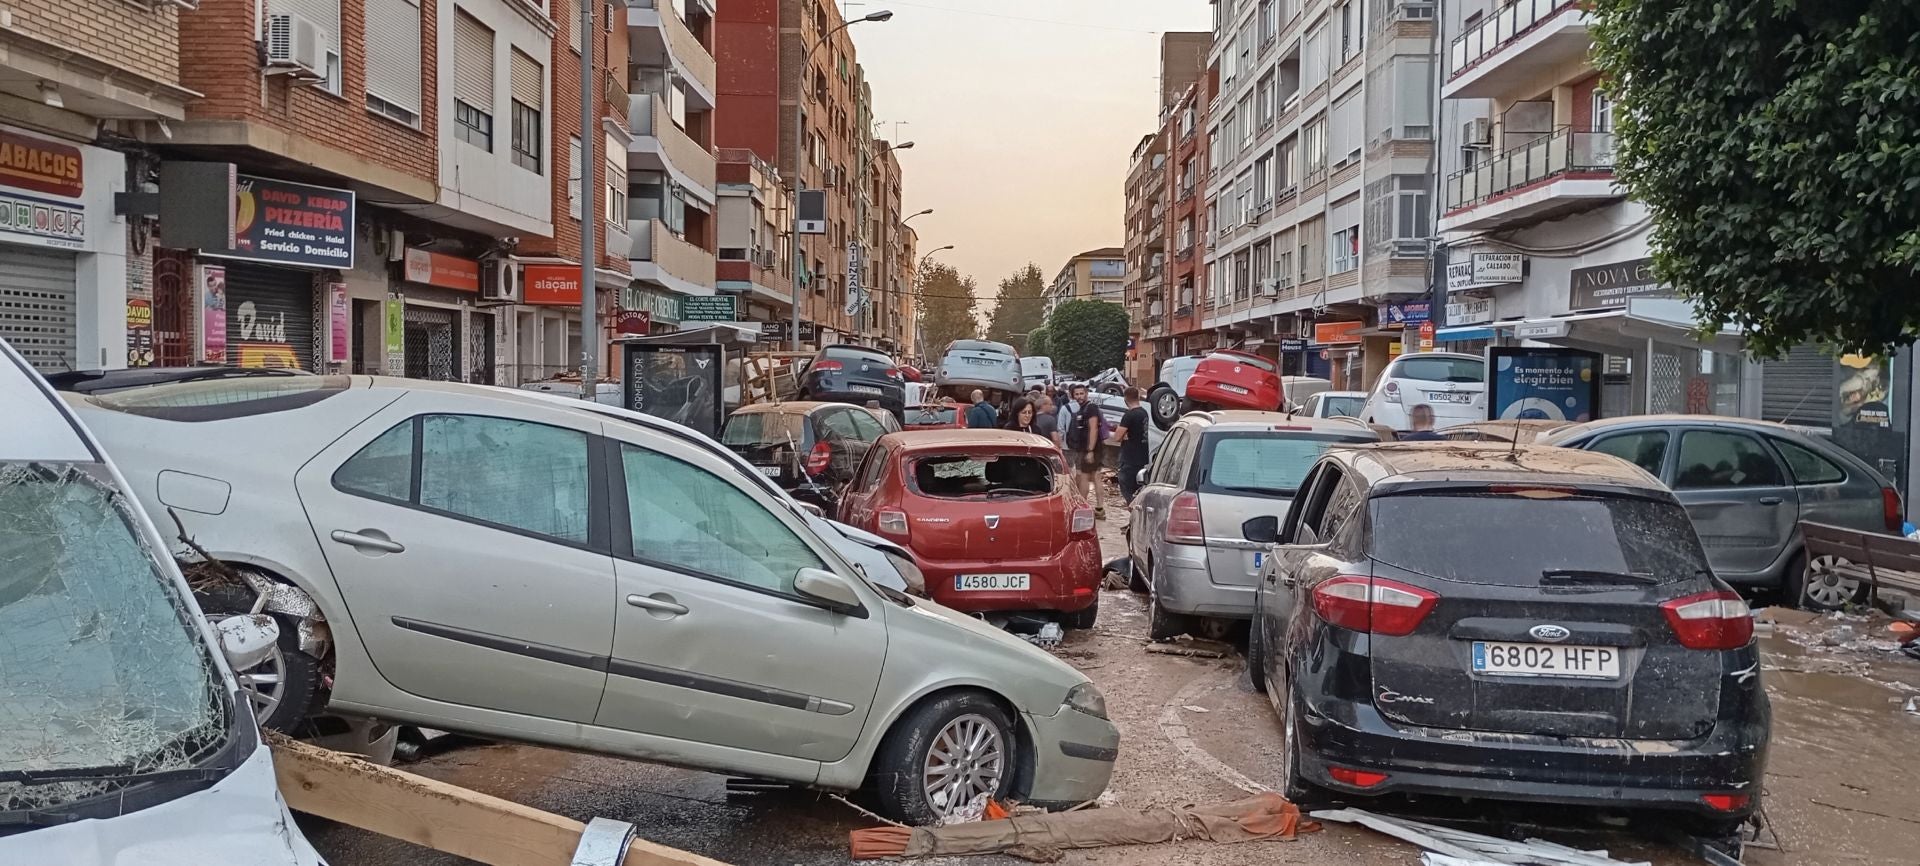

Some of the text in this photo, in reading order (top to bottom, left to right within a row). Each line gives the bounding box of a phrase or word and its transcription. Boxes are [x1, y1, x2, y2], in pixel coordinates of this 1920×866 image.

[0, 142, 78, 179] ABACOS
[237, 181, 254, 192] vid
[262, 189, 347, 210] DAVID KEBAP
[265, 206, 343, 231] PIZZERÍA
[264, 228, 285, 237] Fried
[288, 231, 316, 240] chicken
[260, 240, 348, 258] Servicio Domicilio
[848, 242, 858, 294] ATIENZAR
[1448, 265, 1471, 278] REPARAC
[1586, 267, 1629, 287] NOVA
[535, 280, 578, 293] alaçant
[627, 288, 635, 311] EL
[655, 296, 680, 320] ORIENTAL
[1404, 304, 1430, 312] MOBILE
[127, 306, 150, 318] DAVID
[618, 312, 648, 323] GESTORIA
[1407, 311, 1429, 319] STORE
[237, 301, 287, 344] David
[1420, 323, 1433, 332] ria
[1525, 367, 1563, 375] momento
[634, 358, 643, 411] ORMENTOR
[1549, 374, 1574, 385] bien
[964, 575, 998, 589] 4580
[1002, 575, 1027, 589] JCF
[1538, 627, 1562, 638] Ford
[1491, 645, 1555, 669] 6802
[1564, 647, 1612, 671] HFP
